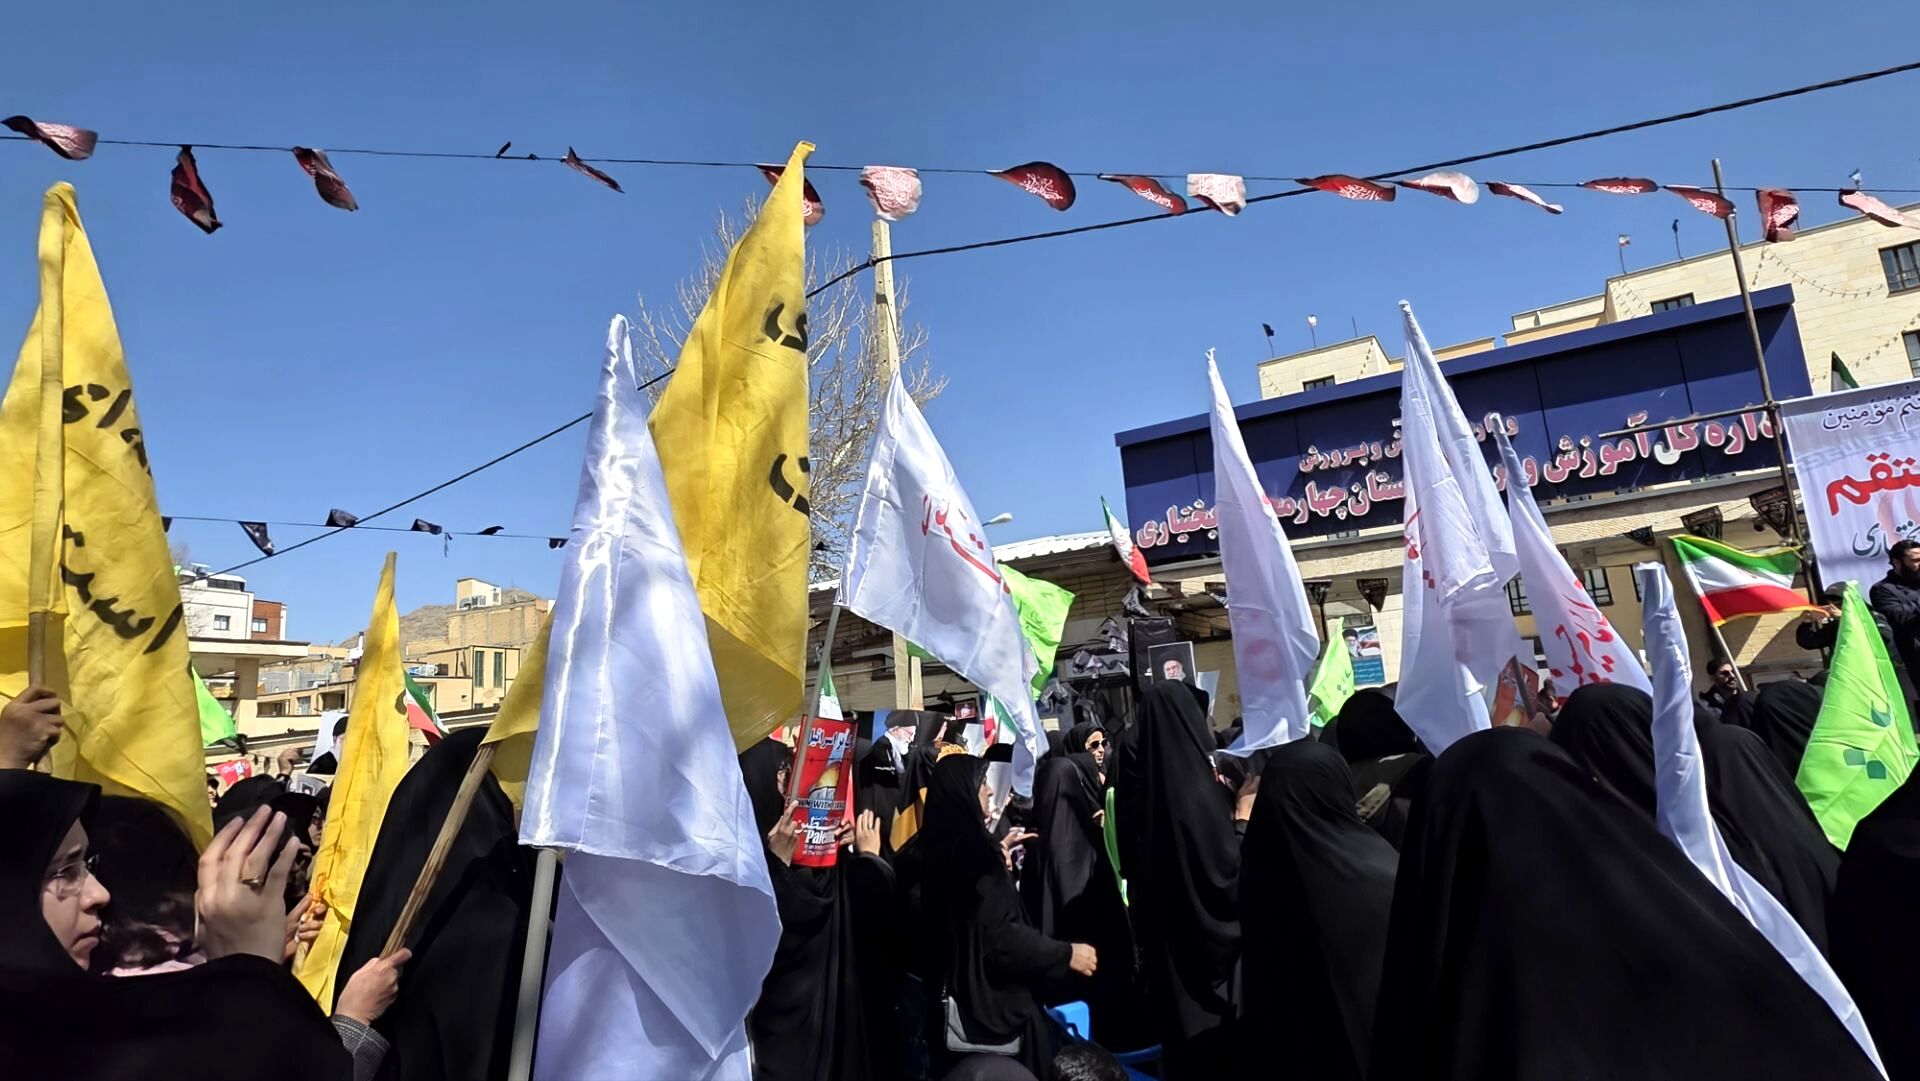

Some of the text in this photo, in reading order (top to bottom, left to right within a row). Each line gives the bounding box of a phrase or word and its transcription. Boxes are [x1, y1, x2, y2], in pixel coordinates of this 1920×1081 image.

[1299, 441, 1369, 473] پرورش
[1543, 410, 1649, 483] آموزش
[1268, 480, 1348, 525] چهارم
[1347, 469, 1405, 517] ستان
